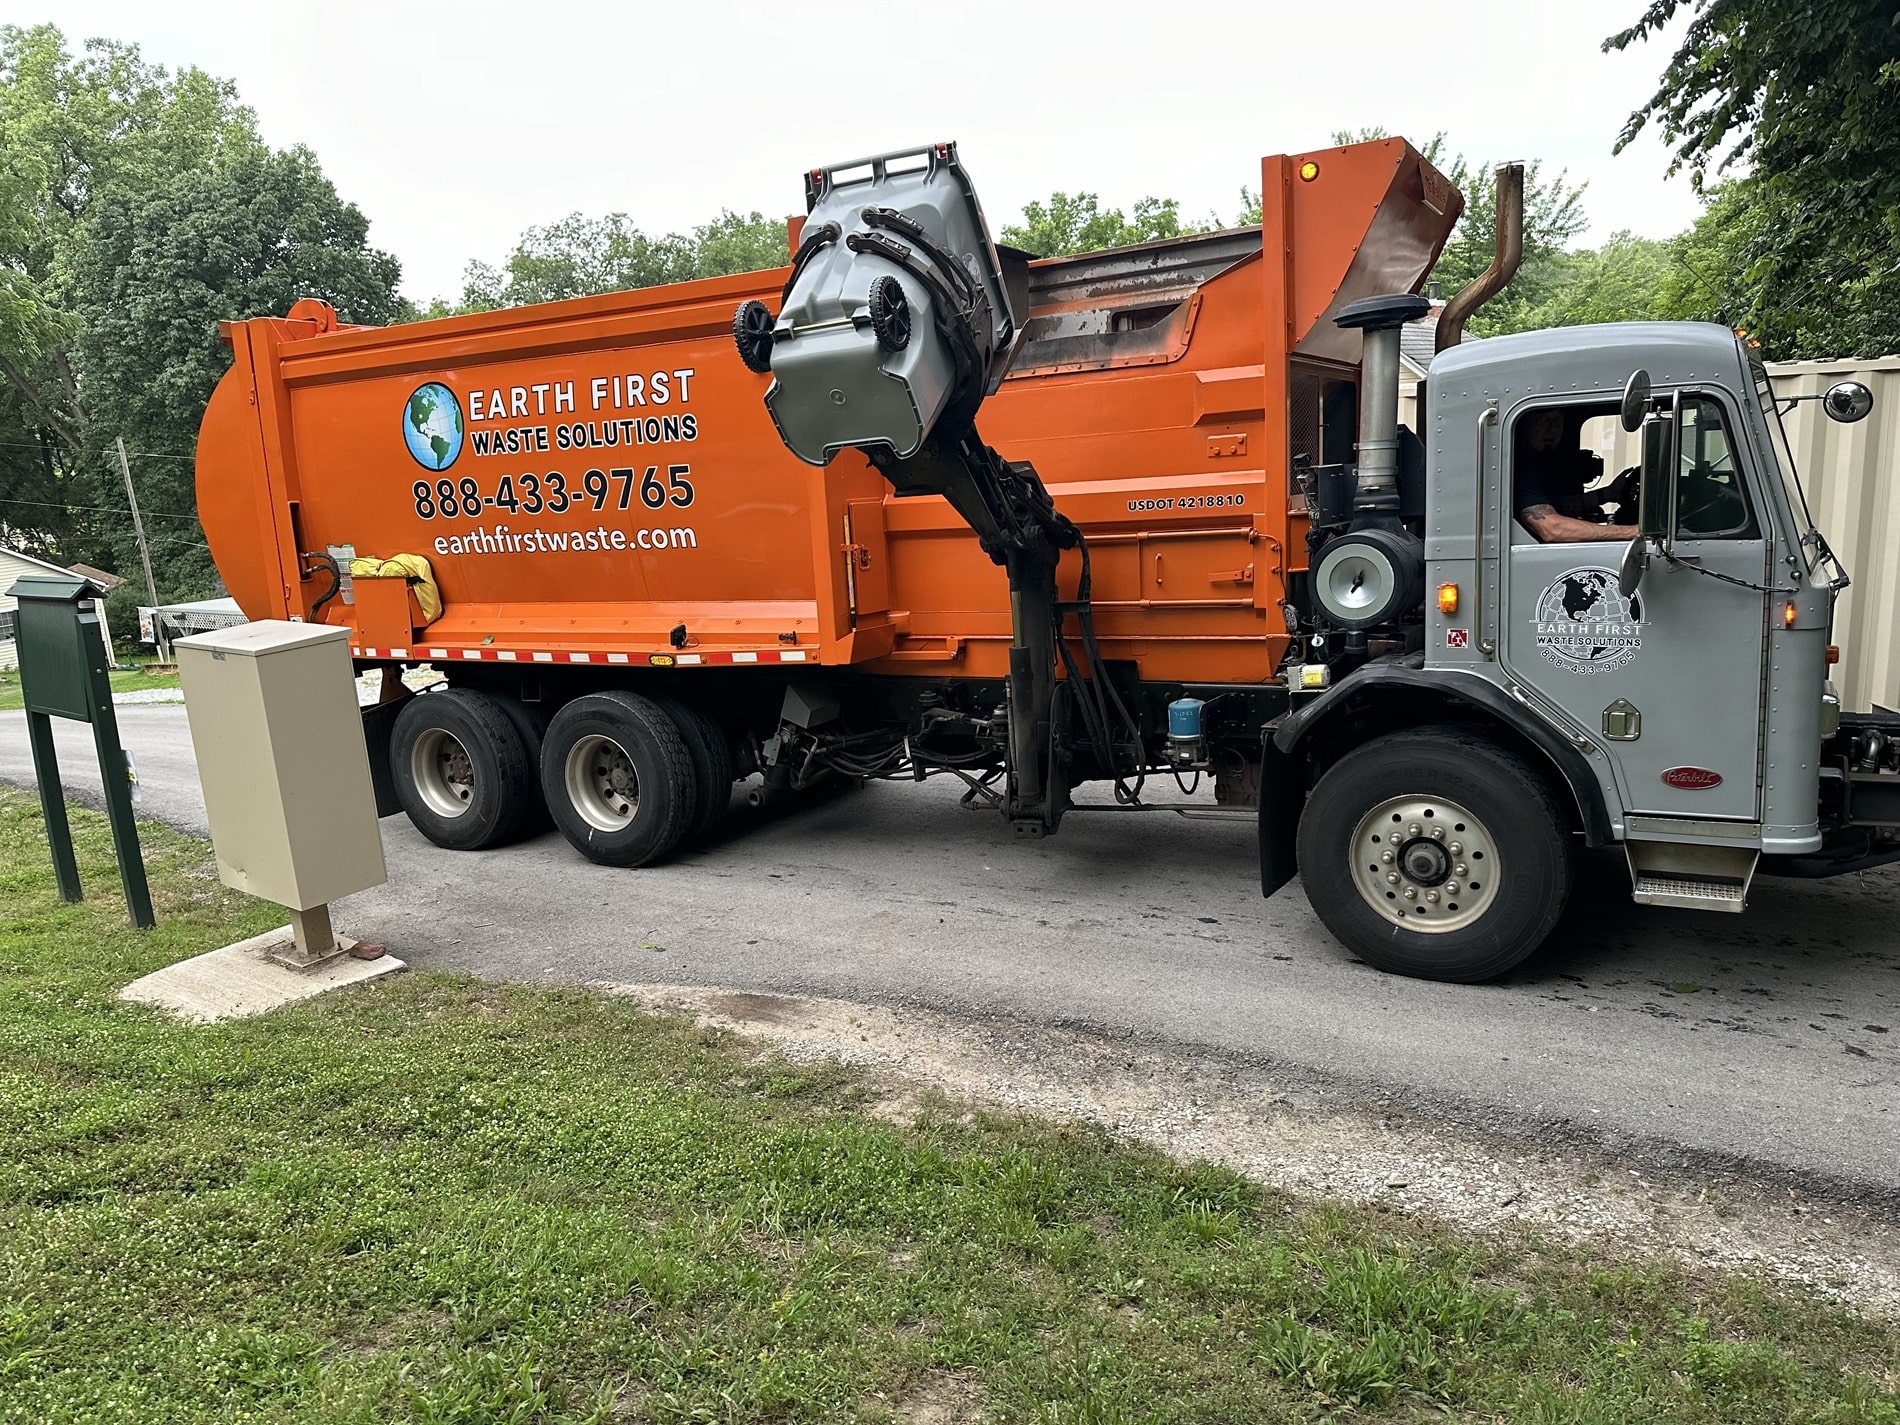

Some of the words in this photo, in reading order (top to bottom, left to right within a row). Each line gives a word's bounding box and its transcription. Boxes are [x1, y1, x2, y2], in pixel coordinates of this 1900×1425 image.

[469, 381, 575, 421] EARTH
[591, 369, 695, 410] FIRST
[471, 427, 550, 456] WASTE
[557, 414, 698, 449] SOLUTIONS
[412, 464, 695, 520] 888-433-9765
[1128, 499, 1175, 511] USDOT
[1178, 495, 1244, 508] 4218810
[434, 525, 698, 555] earthfirstwaste.com
[1537, 624, 1588, 634] EARTH
[1595, 624, 1642, 635] FIRST
[1537, 636, 1574, 645] WASTE
[1578, 637, 1641, 647] SOLUTIONS
[1541, 649, 1635, 675] 888-433-9765
[1666, 770, 1716, 783] Peterbilt
